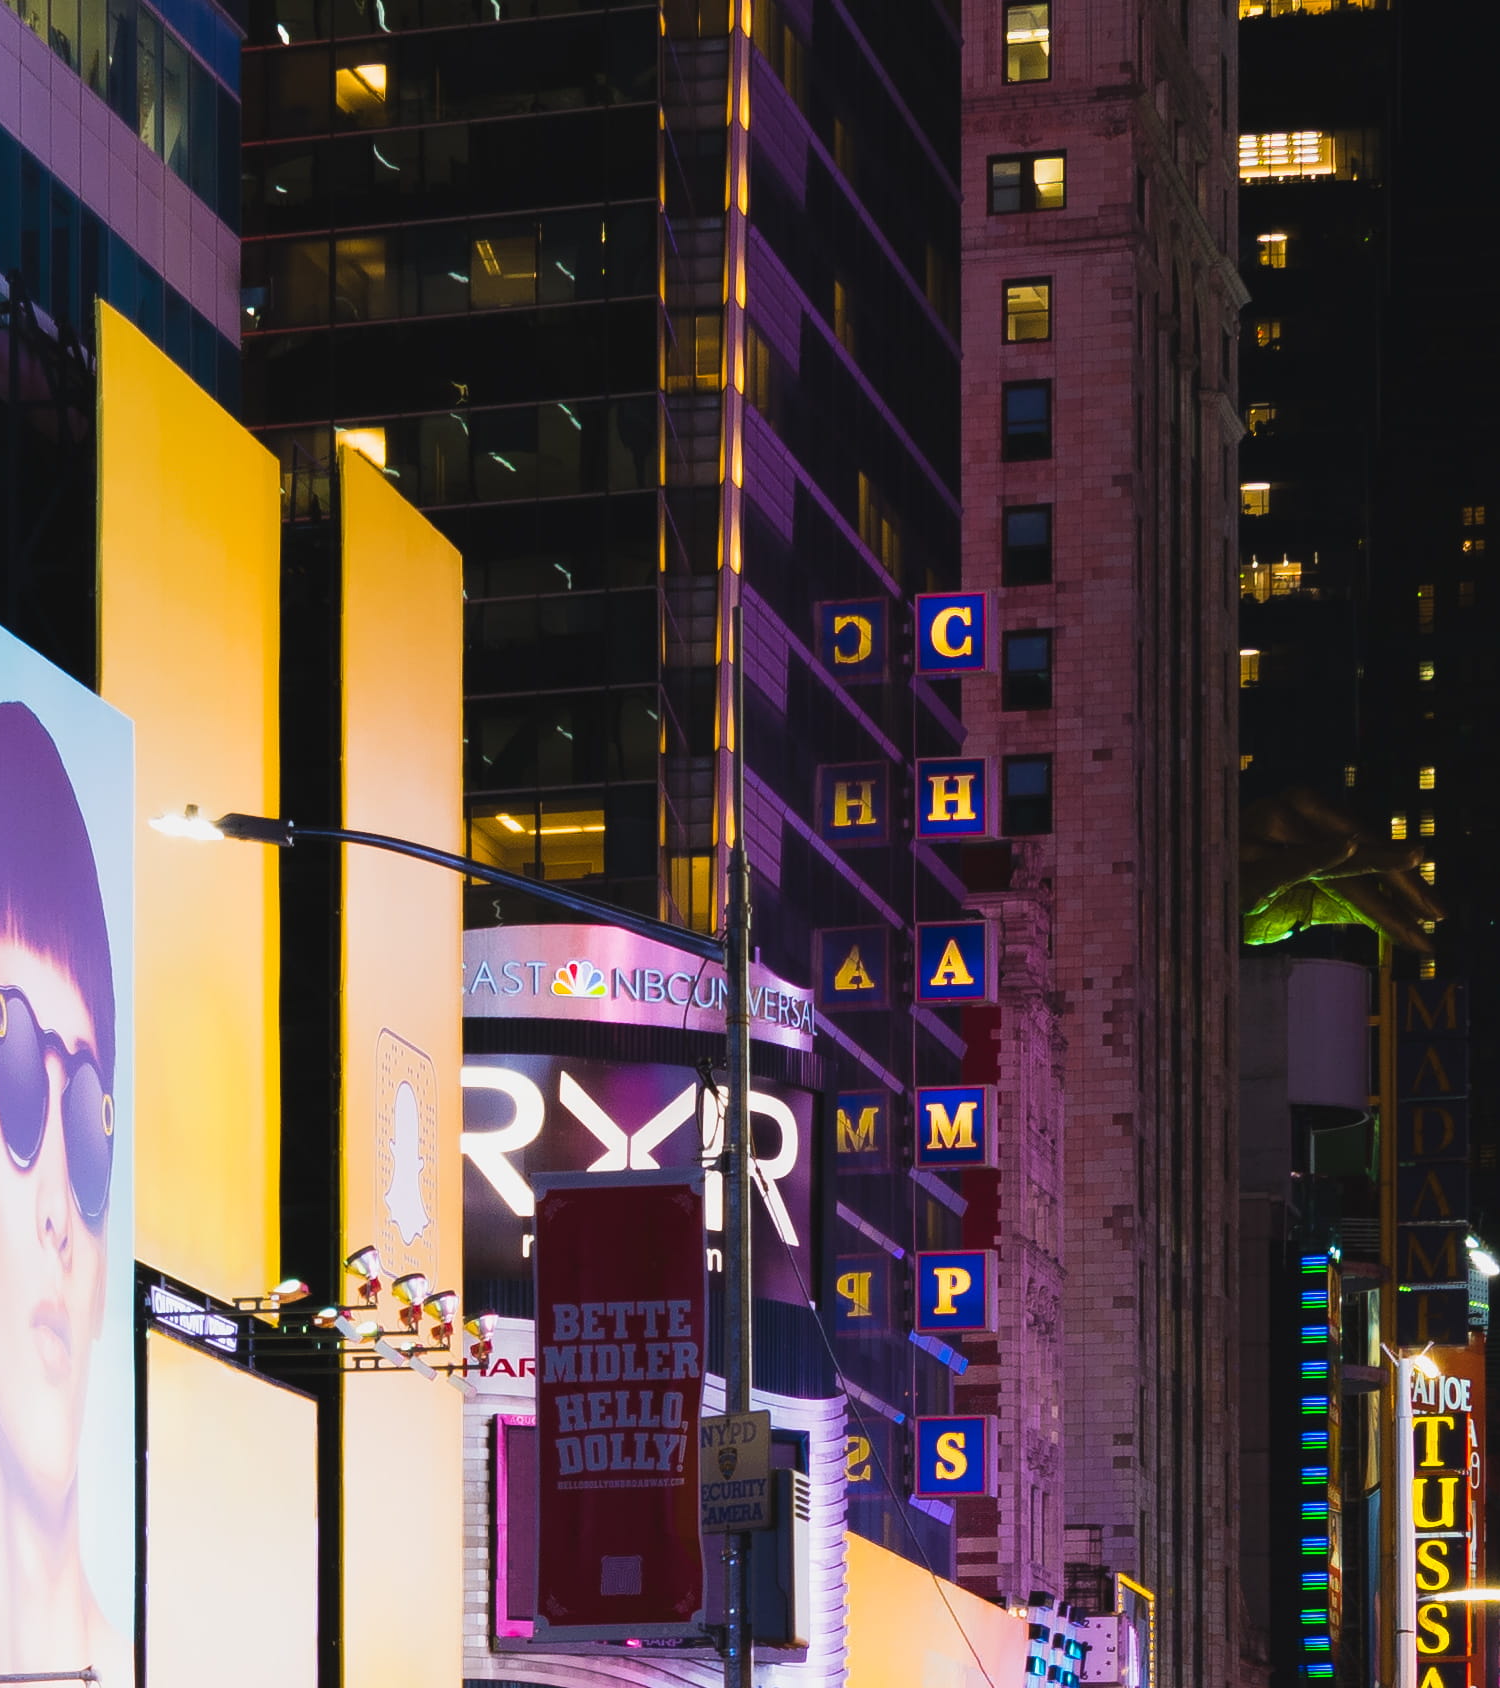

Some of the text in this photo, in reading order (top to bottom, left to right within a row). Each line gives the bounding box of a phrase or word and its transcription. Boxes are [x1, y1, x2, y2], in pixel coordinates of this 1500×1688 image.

[462, 960, 819, 1036] AST NBCUNVERSAL
[927, 606, 979, 1482] CHAMPS
[552, 1300, 692, 1341] BETTE
[542, 1341, 701, 1384] MIDLER
[555, 1390, 689, 1434] HELLO,
[555, 1433, 688, 1476] DOLLY!
[701, 1420, 758, 1450] NYPD
[701, 1477, 768, 1502] ECURITY
